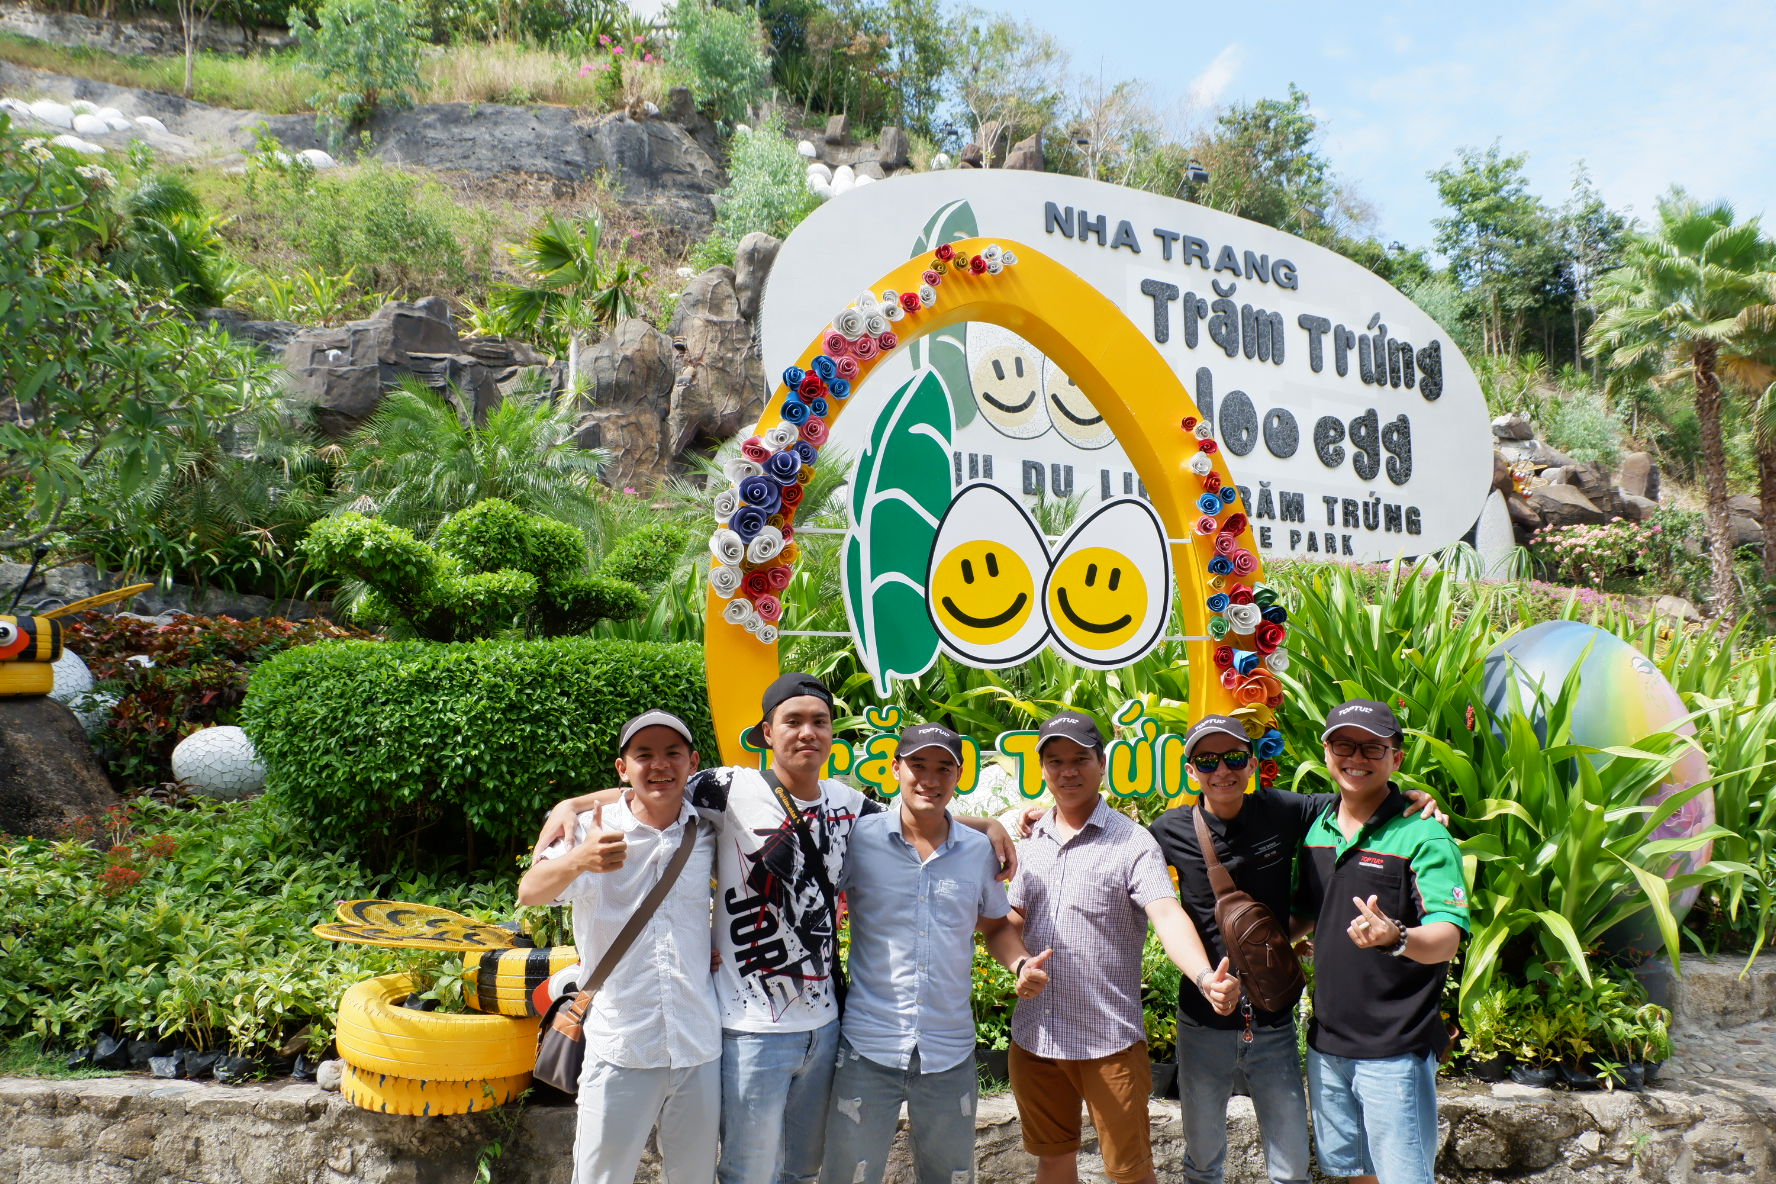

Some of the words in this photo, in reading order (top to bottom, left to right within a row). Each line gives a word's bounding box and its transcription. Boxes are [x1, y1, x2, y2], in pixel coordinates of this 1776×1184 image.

[1045, 201, 1141, 254] NHA
[1153, 227, 1299, 290] TRANG
[1140, 278, 1285, 365] Trăm
[1298, 312, 1443, 401] Trứng
[1313, 408, 1413, 486] egg
[1022, 459, 1074, 499] DU
[1237, 480, 1306, 523] RĂM
[1322, 491, 1422, 535] TRỨNG
[1289, 529, 1354, 556] PARK
